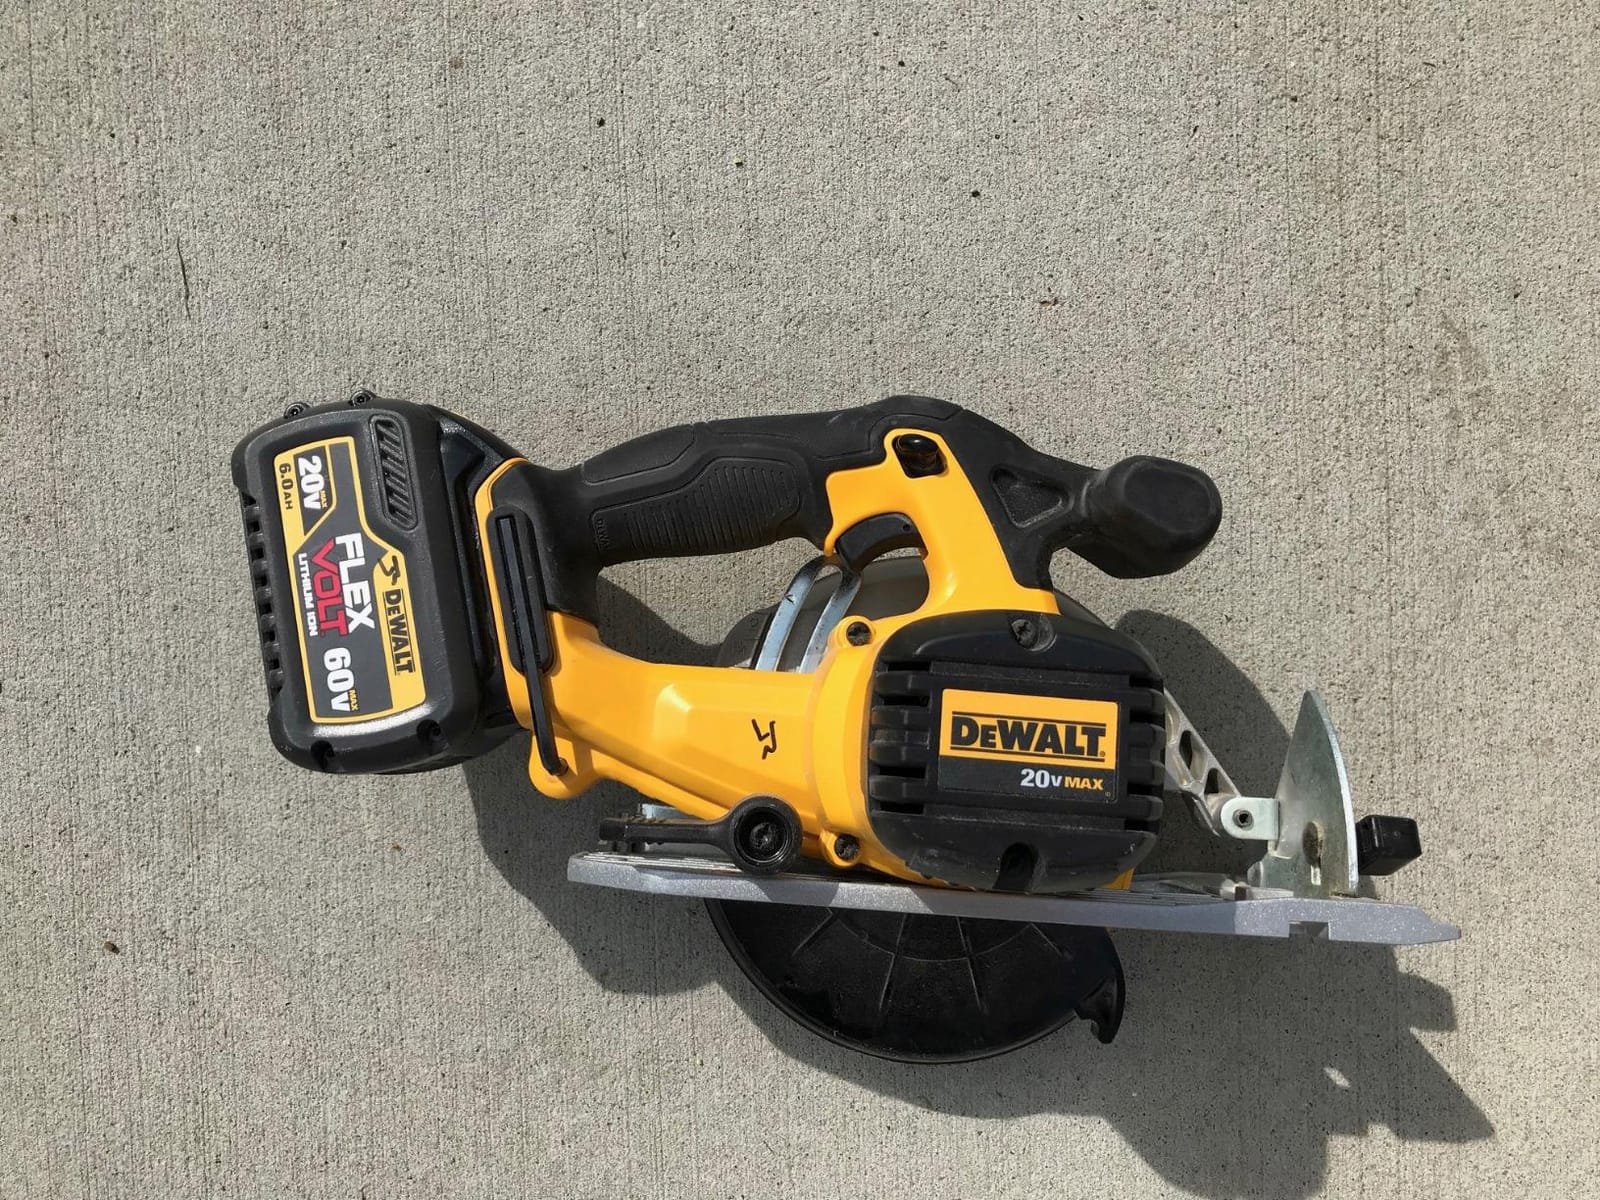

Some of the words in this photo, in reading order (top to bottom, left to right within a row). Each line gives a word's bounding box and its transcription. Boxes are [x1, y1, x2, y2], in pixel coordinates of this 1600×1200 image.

[297, 455, 325, 510] 20V
[319, 490, 329, 508] MAX
[298, 552, 315, 612] LITHIUM
[311, 538, 349, 636] VOLT
[335, 532, 375, 634] FLEX
[306, 612, 319, 637] ION
[323, 647, 355, 712] 60V
[348, 689, 360, 711] MAX
[1064, 775, 1104, 791] MAX
